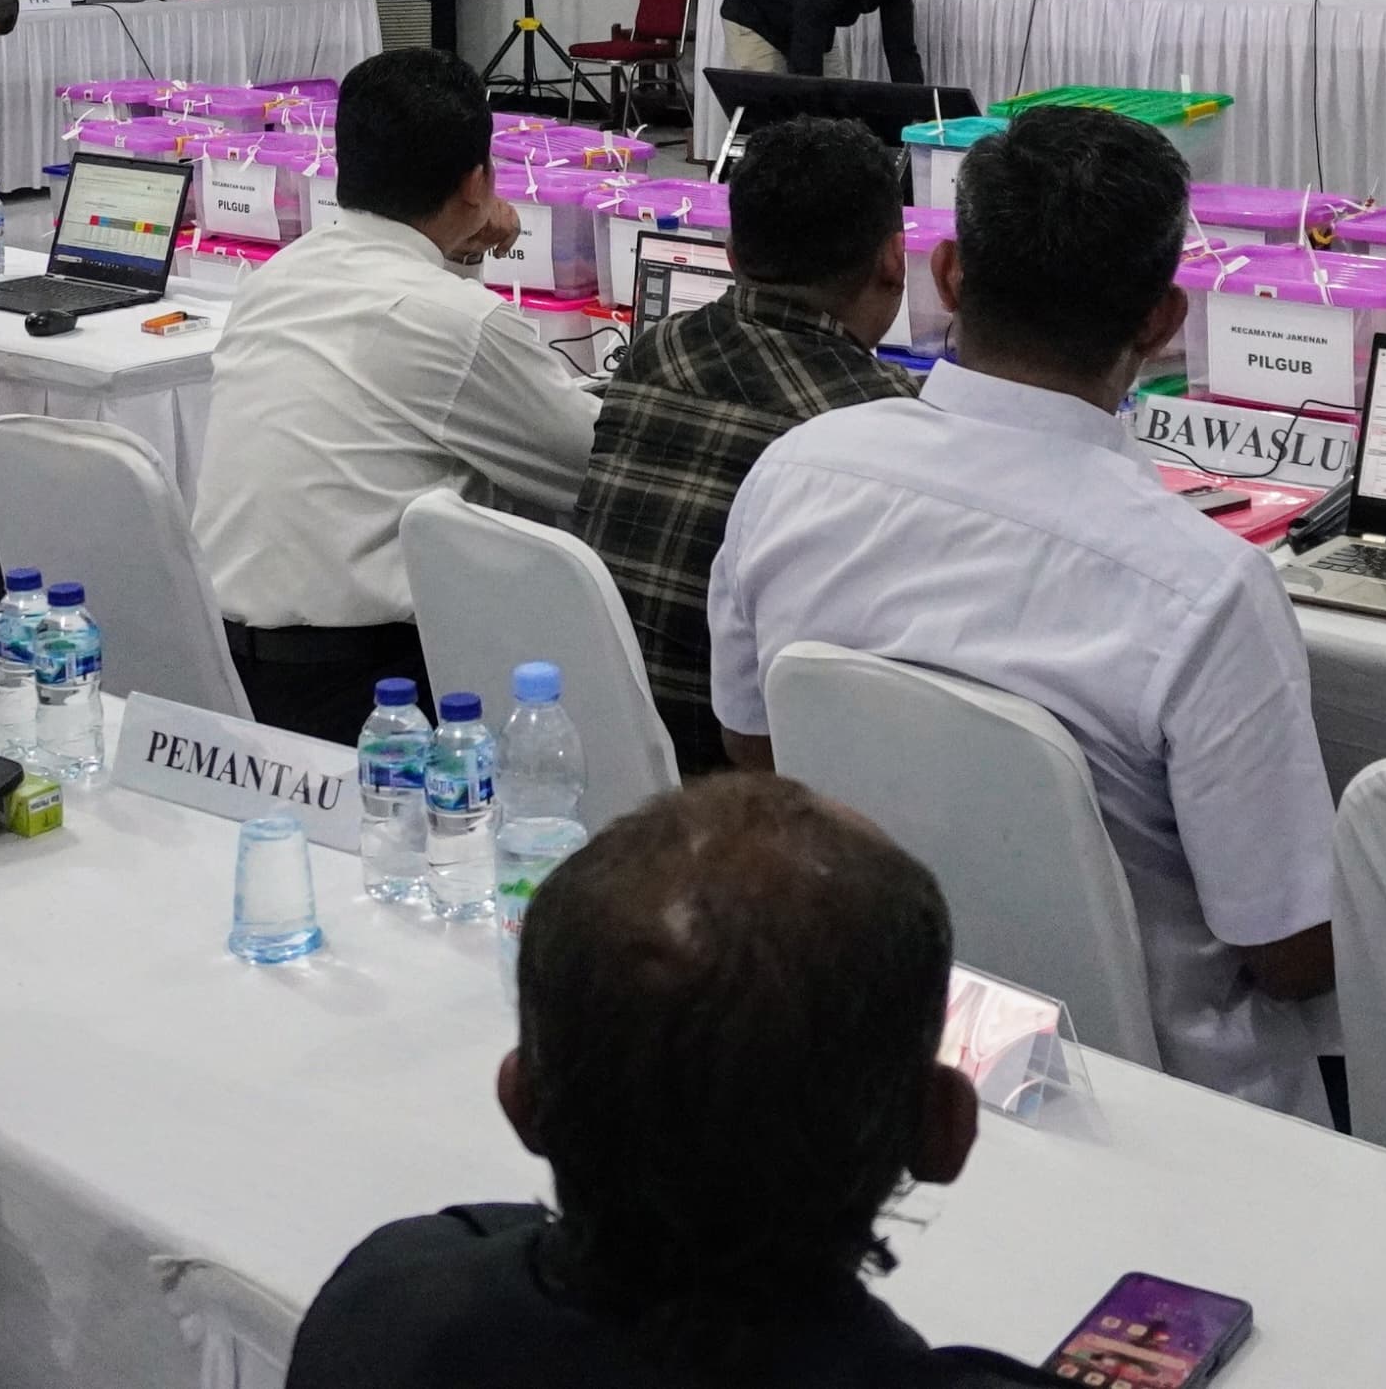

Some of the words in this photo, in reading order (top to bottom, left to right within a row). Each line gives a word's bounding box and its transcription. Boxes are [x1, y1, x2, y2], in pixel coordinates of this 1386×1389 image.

[218, 199, 251, 214] PILGUB
[1231, 326, 1284, 339] KECAMATAN
[1286, 334, 1328, 345] JAKENAN
[1248, 353, 1313, 375] PILGUB
[1148, 408, 1348, 471] BAWASLU
[146, 730, 343, 811] PEMANTAU
